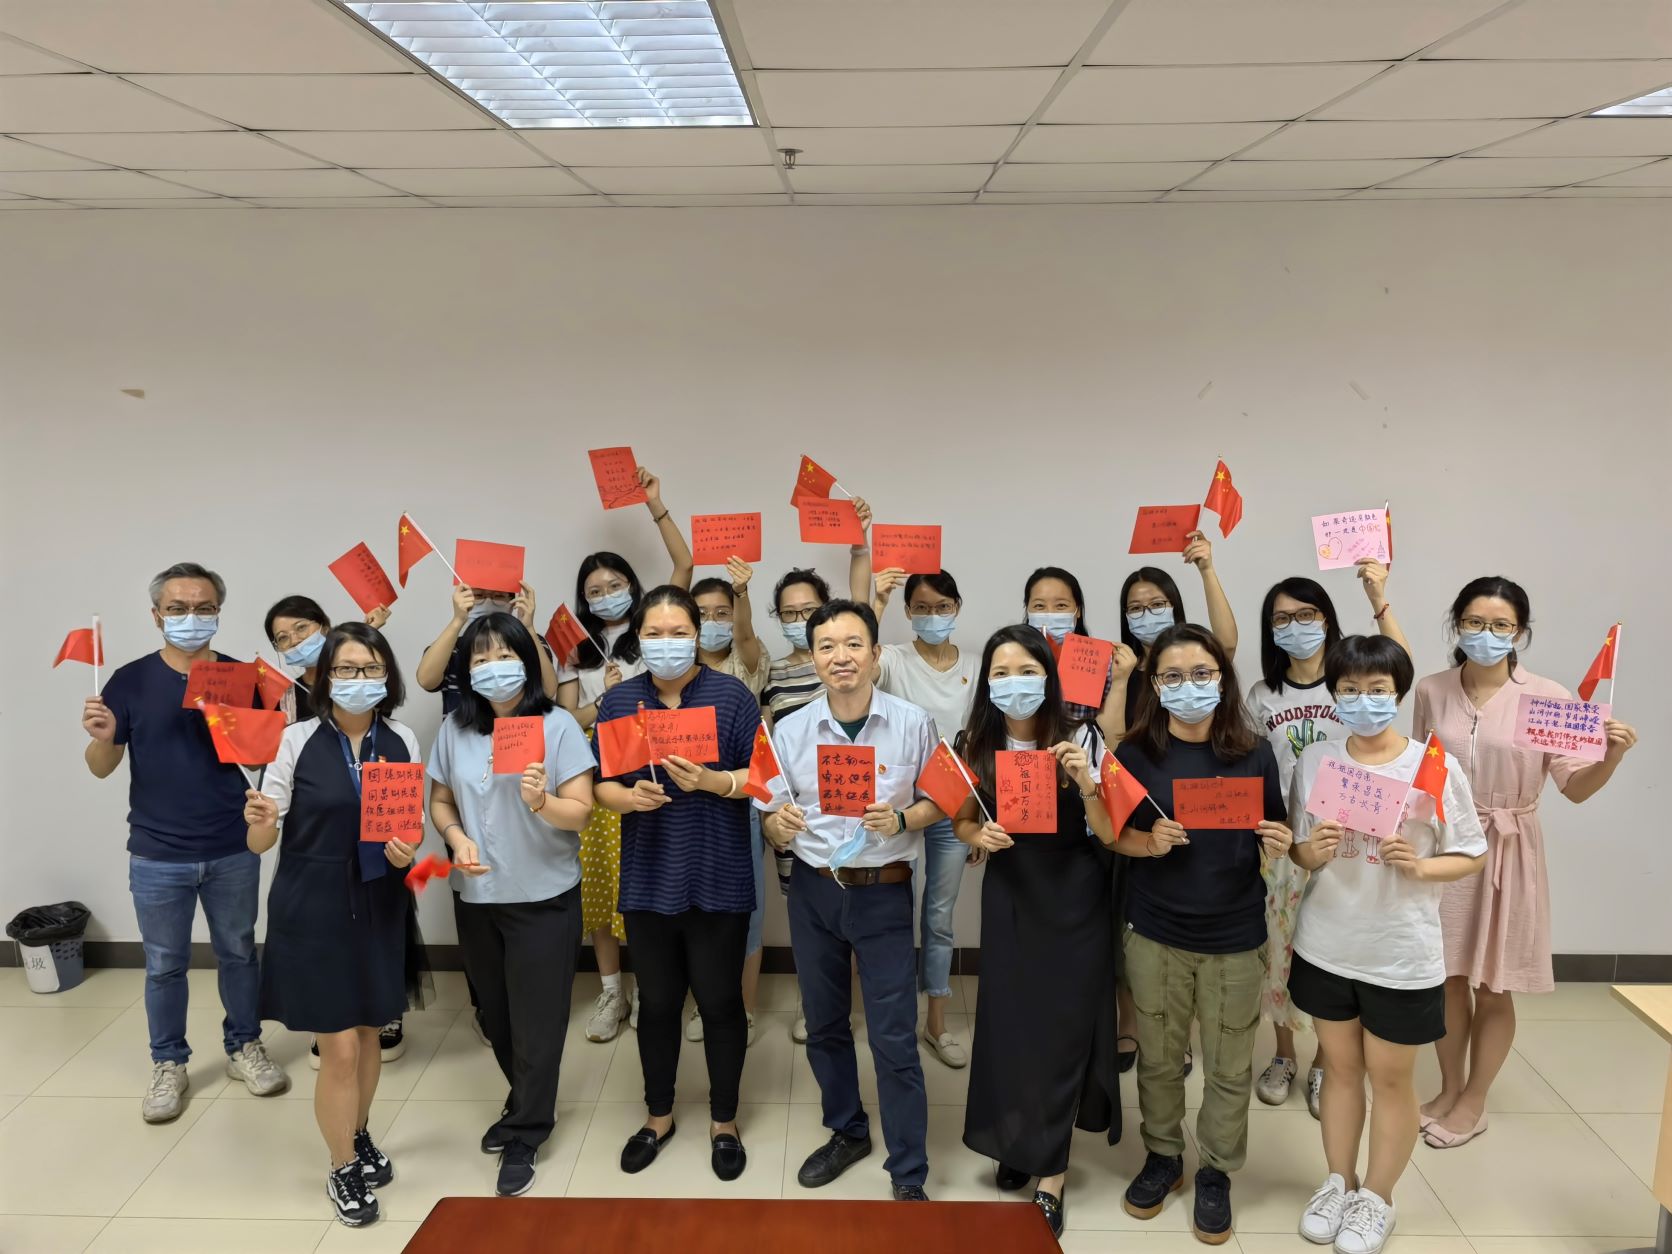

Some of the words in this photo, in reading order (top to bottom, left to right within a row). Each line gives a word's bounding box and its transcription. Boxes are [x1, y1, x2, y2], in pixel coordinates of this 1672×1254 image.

[1266, 705, 1344, 732] WOODSTOC
[822, 753, 872, 766] 不忘初心
[822, 769, 871, 788] 牢记使命
